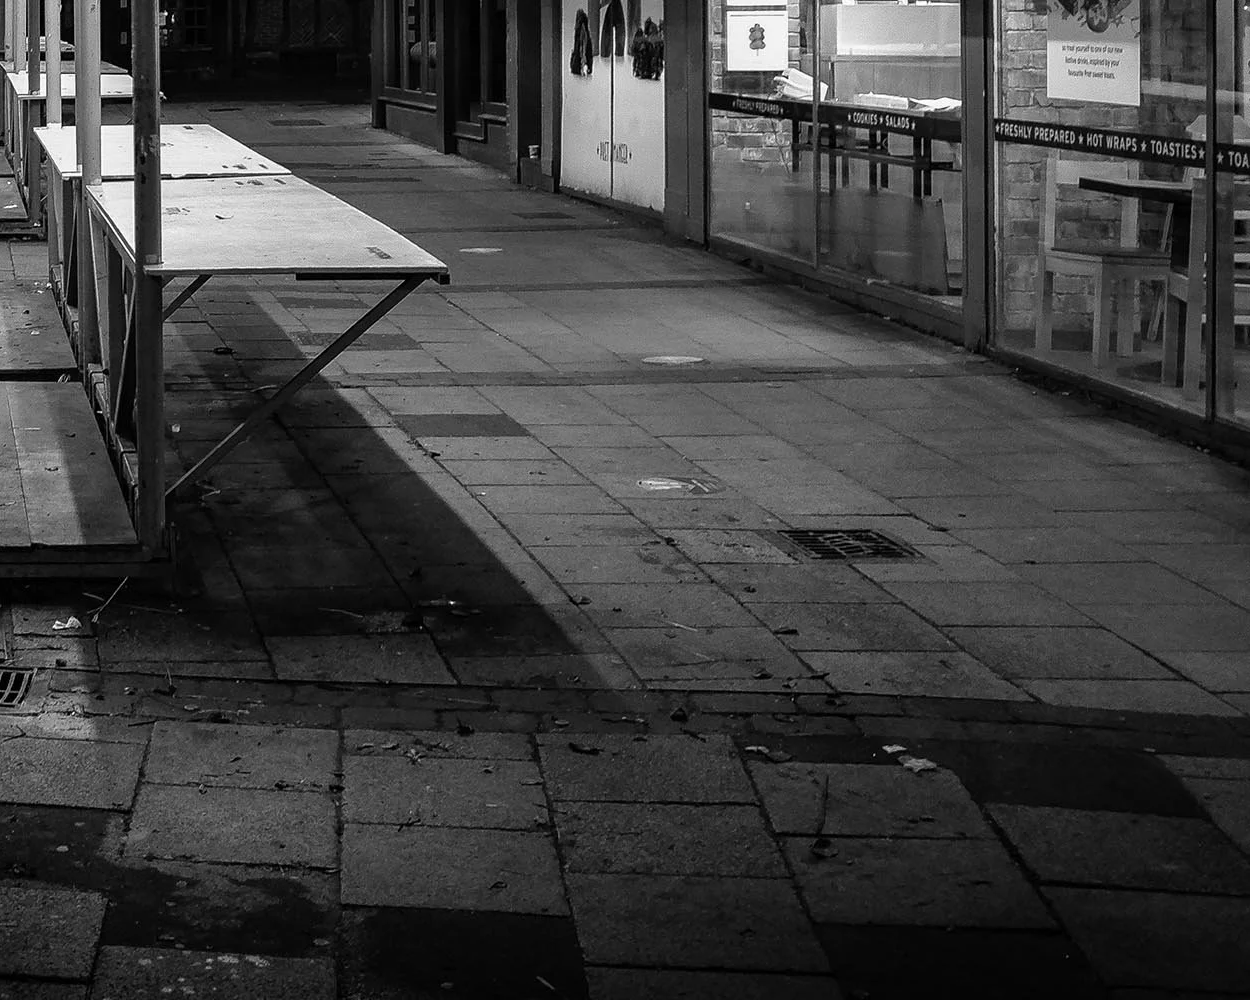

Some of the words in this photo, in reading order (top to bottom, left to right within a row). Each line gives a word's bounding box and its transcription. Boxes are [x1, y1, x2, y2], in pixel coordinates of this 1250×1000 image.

[853, 111, 878, 125] COOKIES
[885, 114, 910, 129] SALADS
[999, 122, 1033, 139] FRESHLY
[1034, 127, 1076, 145] PREPARED
[1086, 133, 1103, 148] HOT
[1106, 136, 1138, 153] WRAPS
[1150, 140, 1198, 160] TOASTIES
